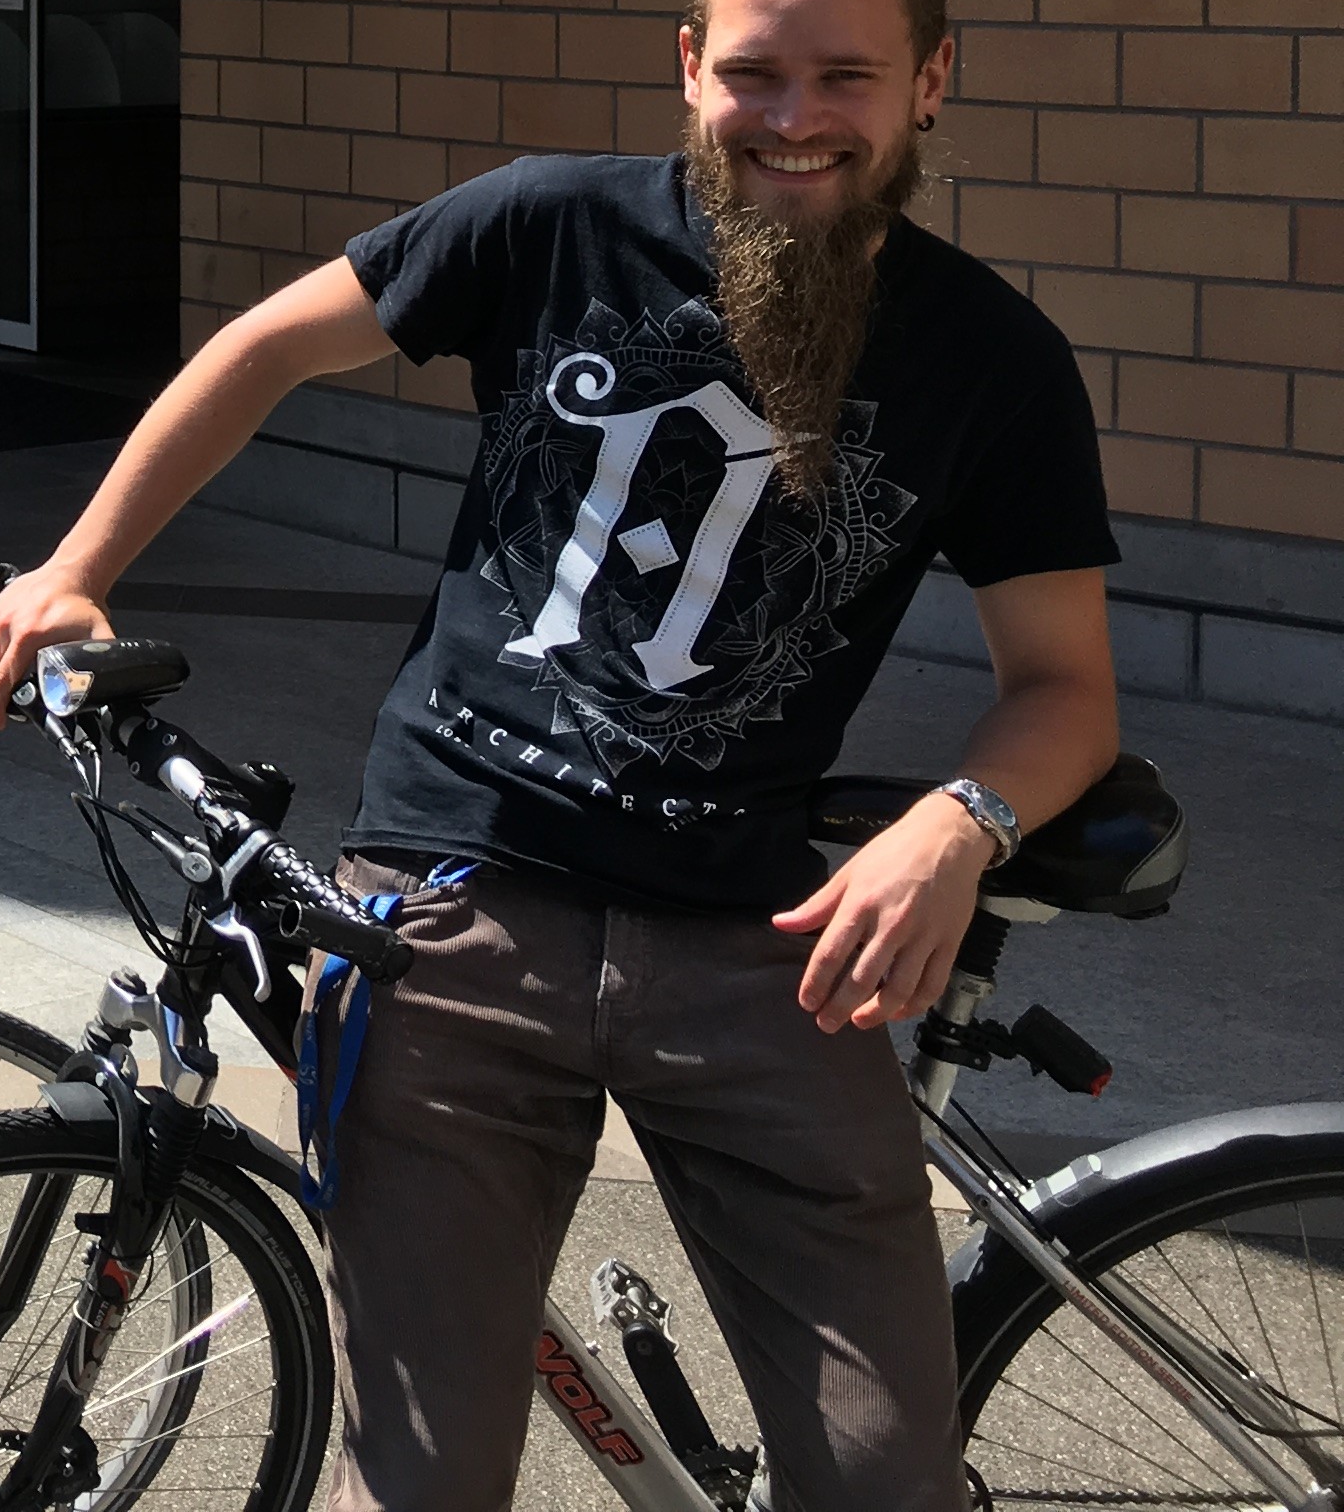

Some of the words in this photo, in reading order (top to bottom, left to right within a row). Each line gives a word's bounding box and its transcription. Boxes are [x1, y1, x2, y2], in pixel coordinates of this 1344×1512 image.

[1062, 1279, 1110, 1324] LIMITED
[1111, 1323, 1160, 1370] EDITION
[1157, 1365, 1194, 1402] SERIE
